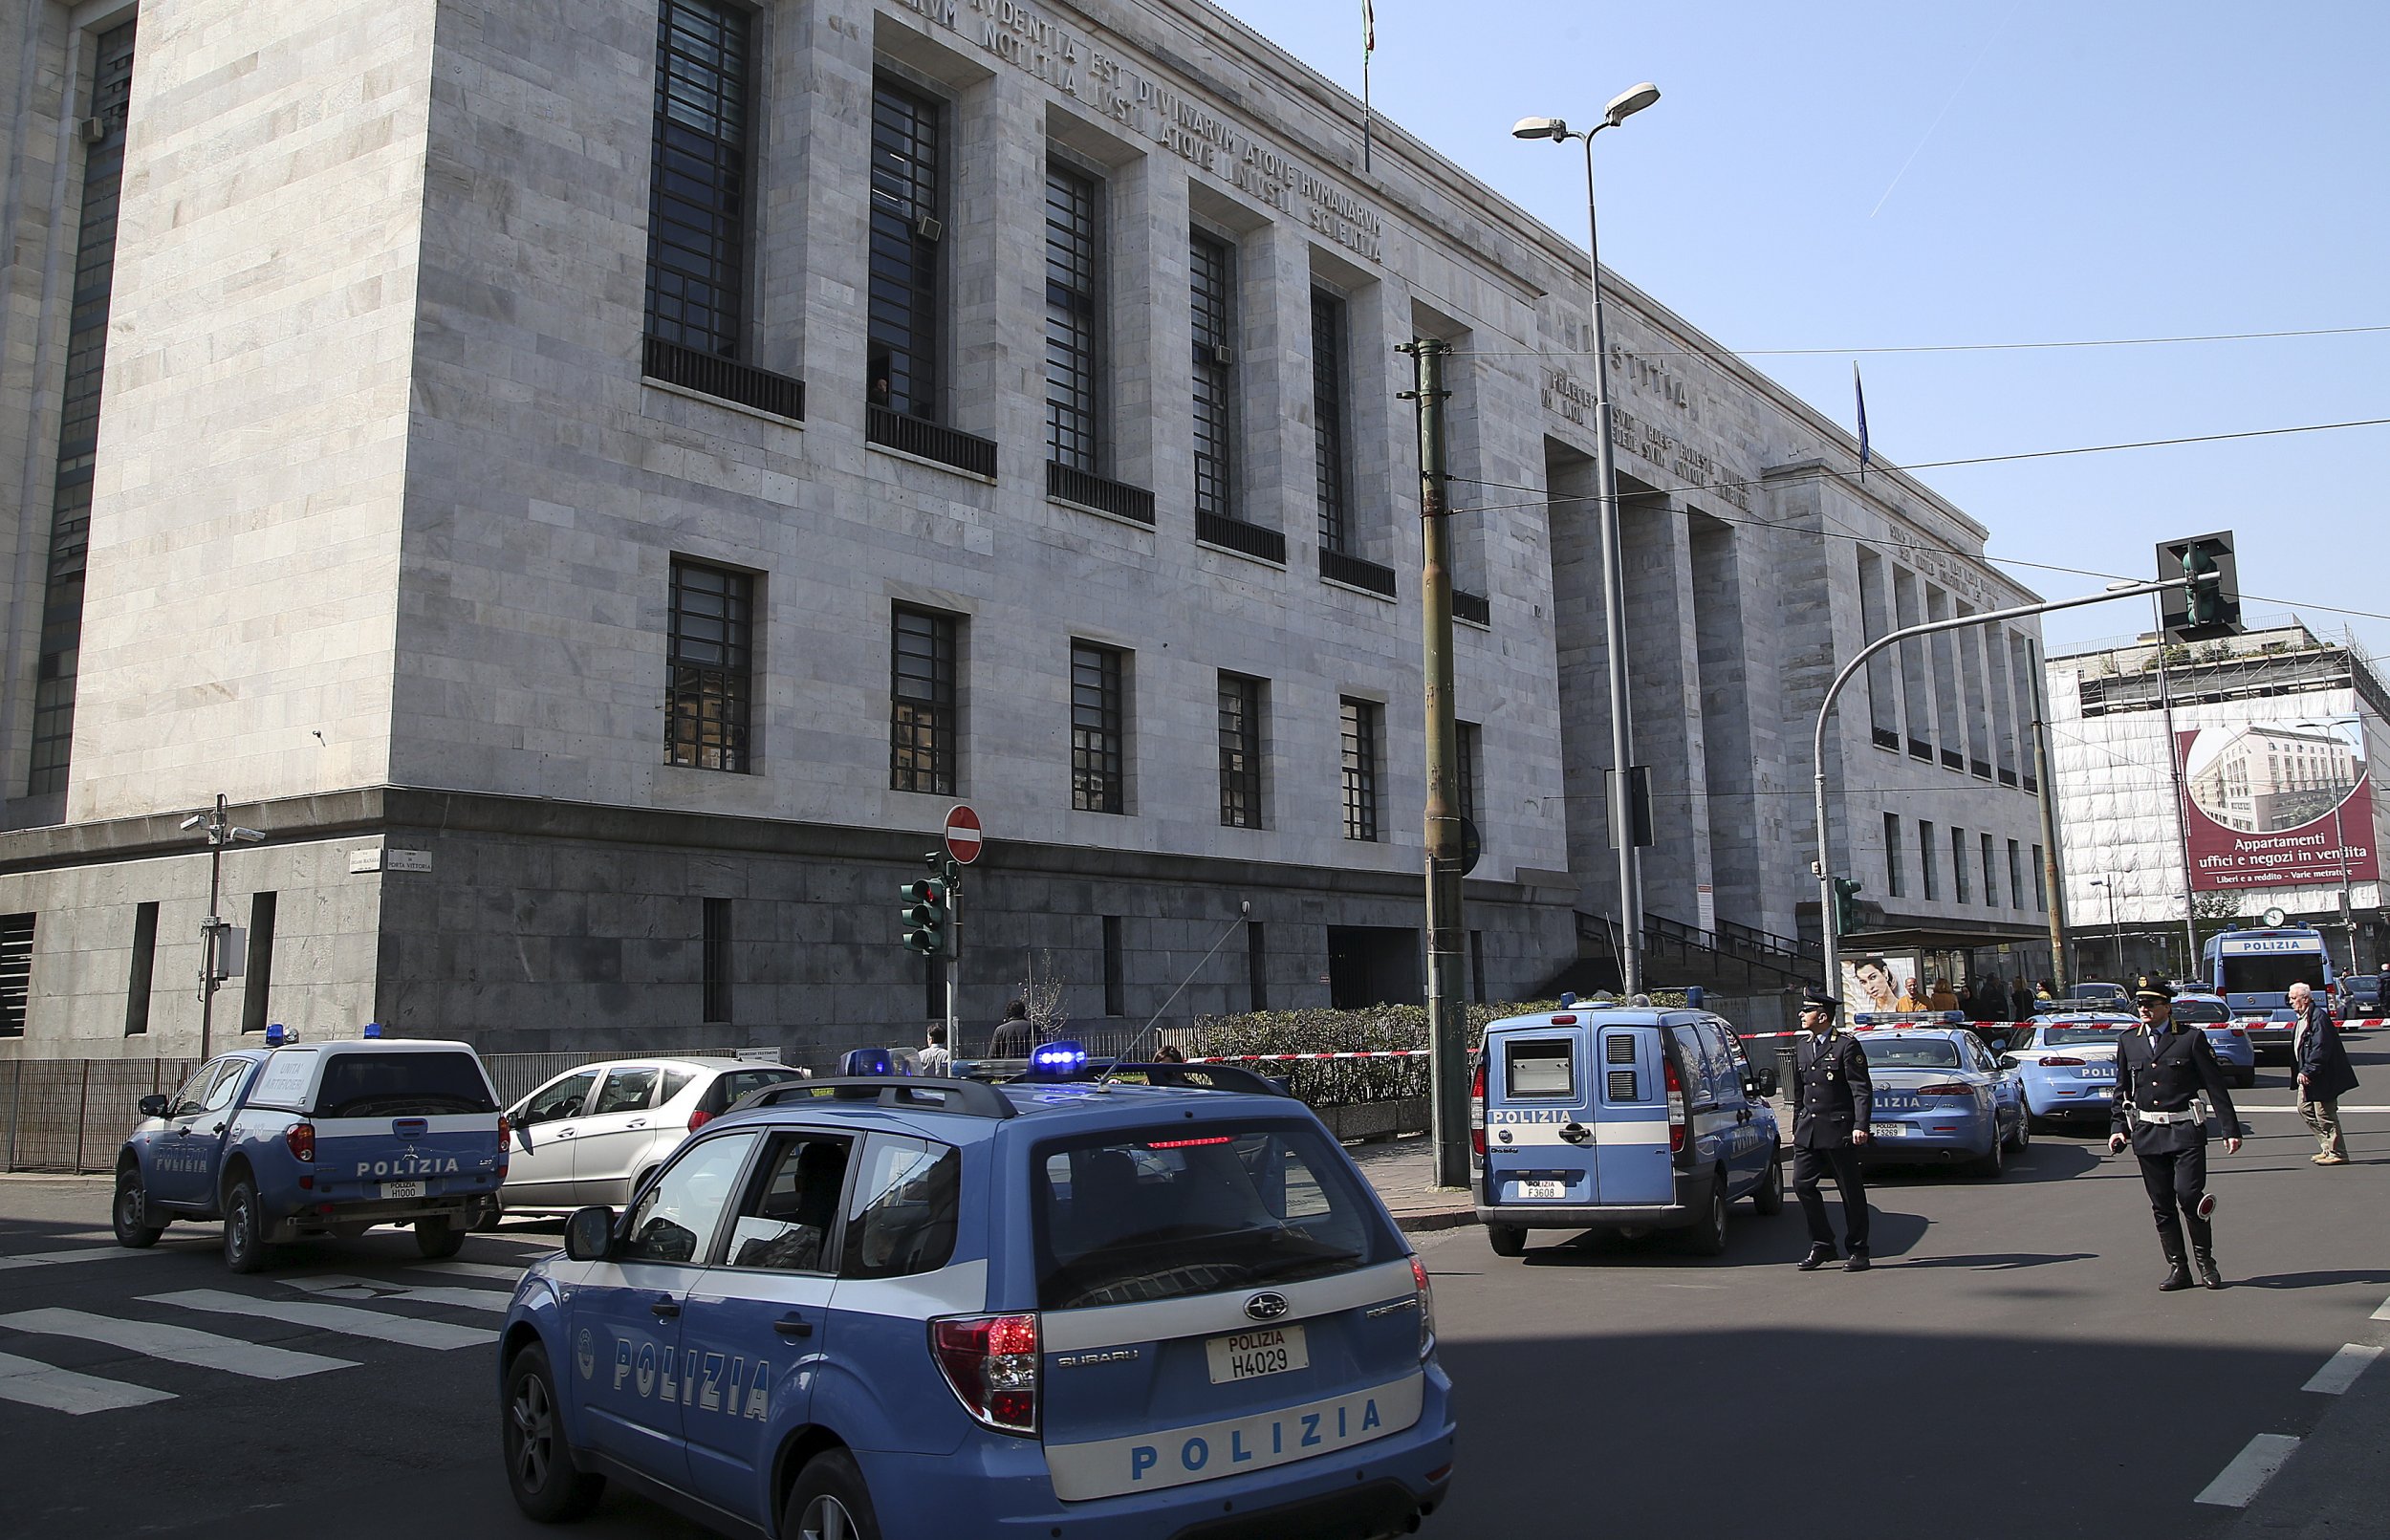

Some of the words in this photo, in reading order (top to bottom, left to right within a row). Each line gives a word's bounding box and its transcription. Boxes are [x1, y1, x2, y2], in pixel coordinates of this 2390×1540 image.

[980, 20, 1076, 97] NOTITIA
[1088, 81, 1145, 133] IVSTI
[1158, 121, 1214, 170] ATQVE
[1221, 152, 1291, 213] INIVSTI
[1309, 206, 1382, 264] SCIENTIA
[1089, 49, 1123, 90] EST
[1133, 76, 1236, 154] DIVINARVM
[1243, 139, 1294, 187] ATQVE
[1298, 171, 1382, 238] HVMANARVM
[2234, 832, 2326, 853] Appartamenti
[2199, 854, 2233, 868] uffici
[2238, 856, 2246, 866] e
[2249, 851, 2293, 867] negozi
[2298, 849, 2312, 861] in
[2216, 876, 2239, 884] Liberi
[2254, 873, 2283, 881] reddito
[2291, 871, 2312, 879] Varie
[2243, 941, 2300, 951] POLIZIA
[2082, 1068, 2118, 1077] POLI
[1875, 1097, 1921, 1108] LIZIA
[1492, 1110, 1572, 1124] POLIZIA
[357, 1157, 460, 1177] POLIZIA
[391, 1187, 416, 1198] H1000
[1528, 1188, 1555, 1198] F3608
[1228, 1329, 1286, 1353] POLIZIA
[1057, 1349, 1140, 1368] SUBARU
[1231, 1347, 1289, 1379] H4029
[614, 1337, 770, 1422] POLIZIA
[1132, 1399, 1380, 1481] POLIZIA
